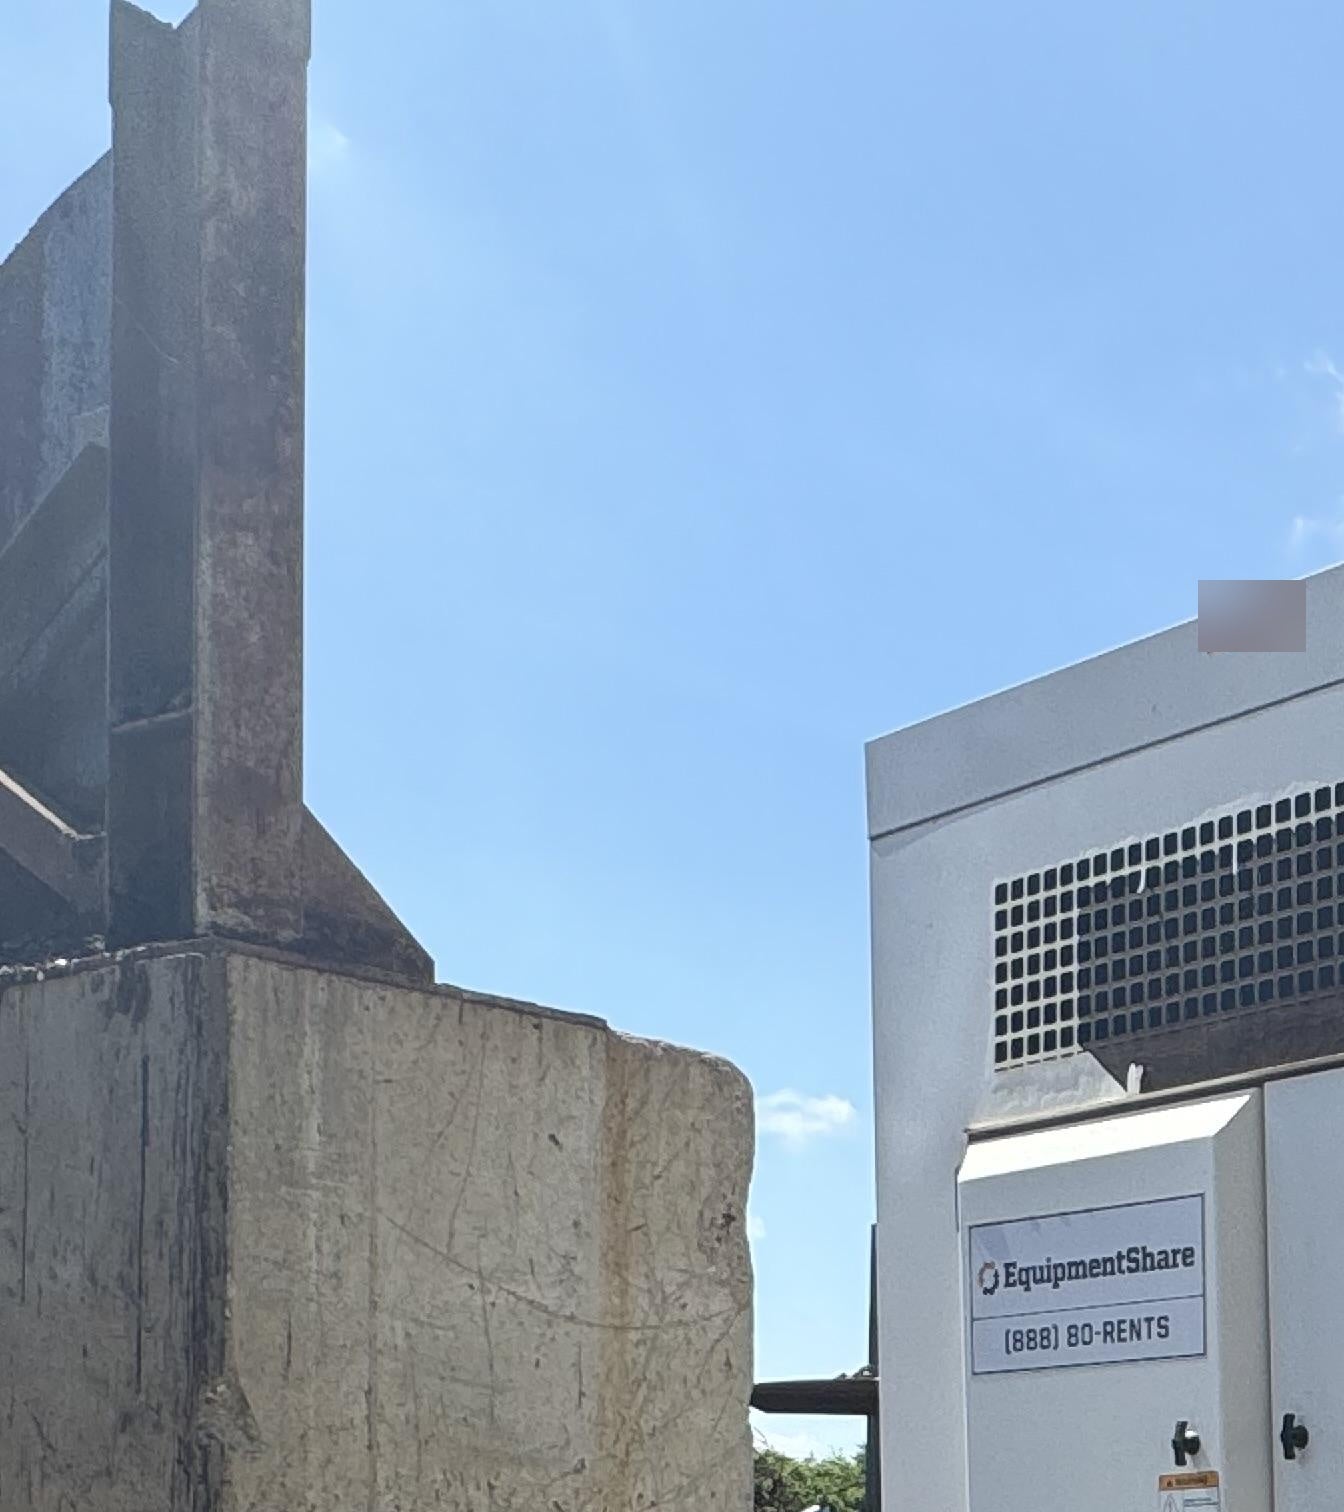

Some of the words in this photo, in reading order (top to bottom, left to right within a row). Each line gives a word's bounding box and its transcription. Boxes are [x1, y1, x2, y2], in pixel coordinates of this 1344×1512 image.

[1003, 1245, 1196, 1291] EquipmentShare
[1004, 1323, 1059, 1355] (888)
[1066, 1315, 1170, 1348] 80-RENTS
